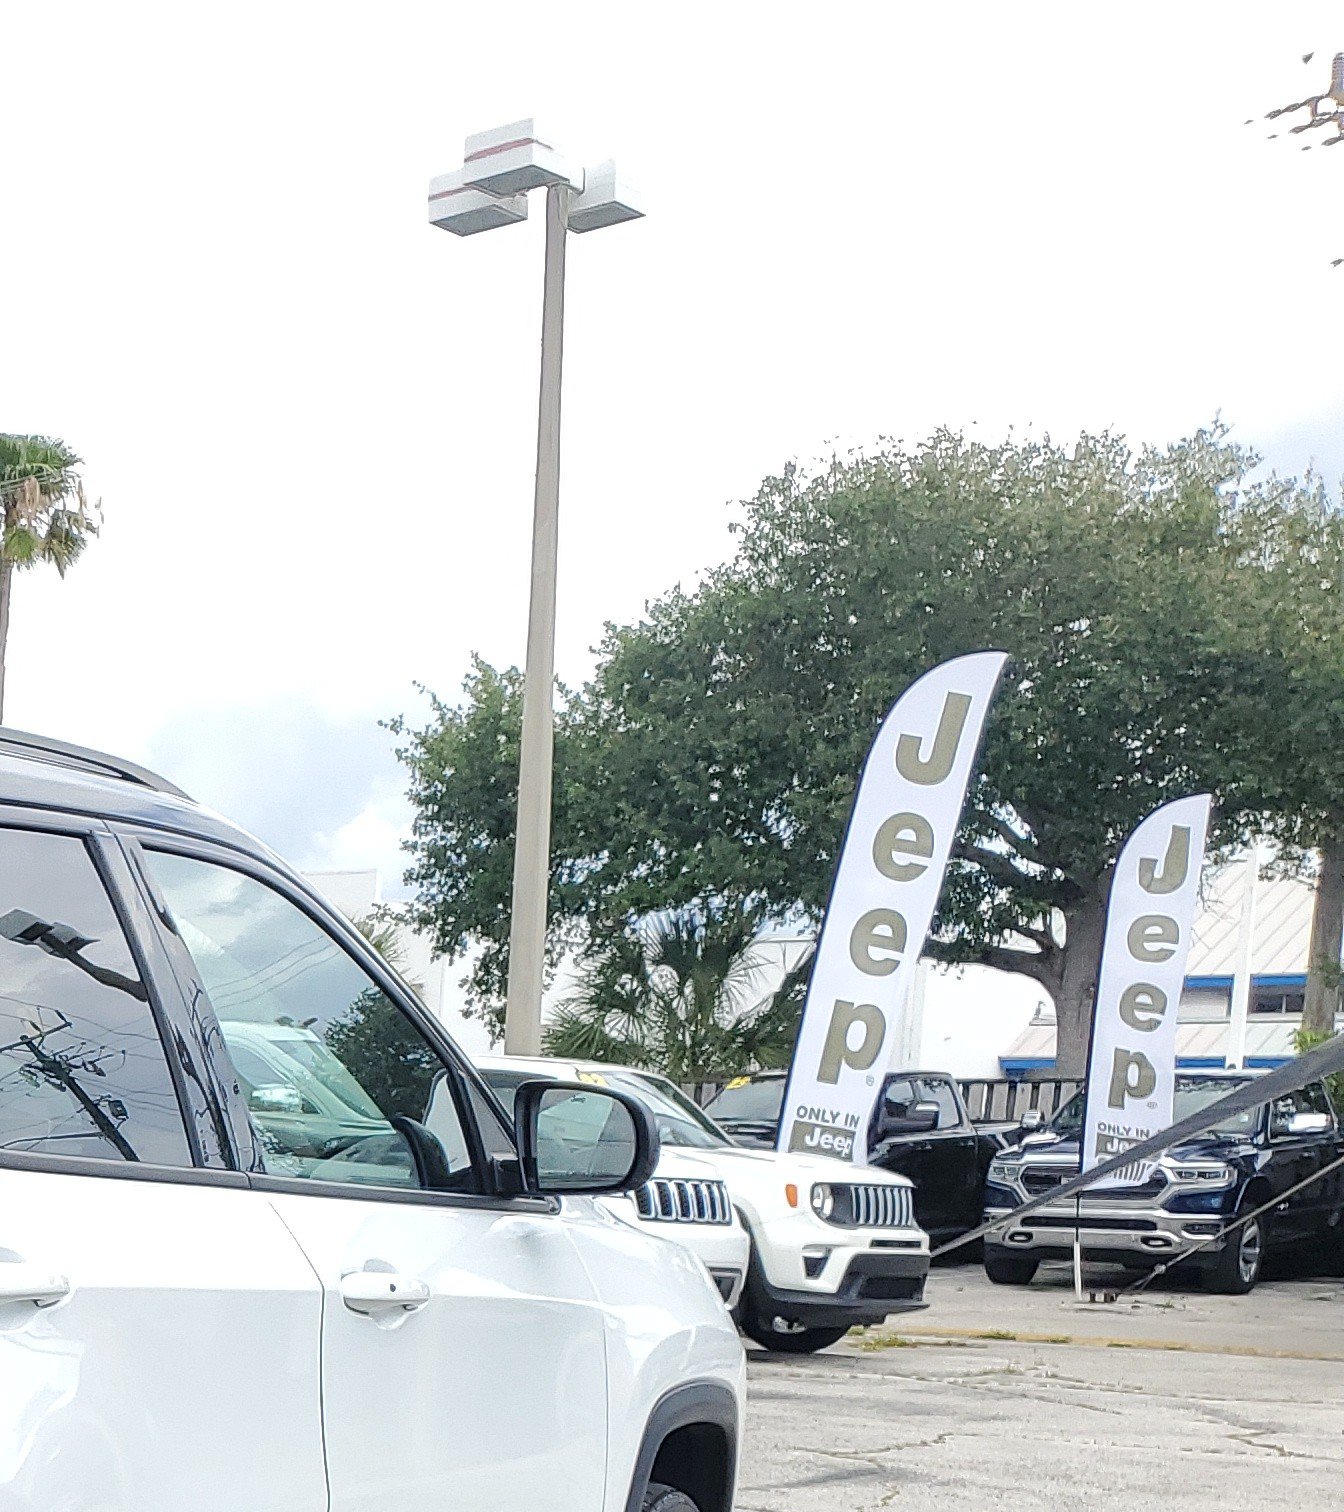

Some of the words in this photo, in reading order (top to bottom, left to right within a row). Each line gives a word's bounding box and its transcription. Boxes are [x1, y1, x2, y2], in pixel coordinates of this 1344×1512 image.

[816, 691, 972, 1085] Jeep
[1108, 825, 1190, 1110] Jeep
[796, 1105, 841, 1124] ONLY
[844, 1112, 861, 1129] IN
[1097, 1121, 1132, 1136] ONLY
[1135, 1127, 1150, 1138] IN
